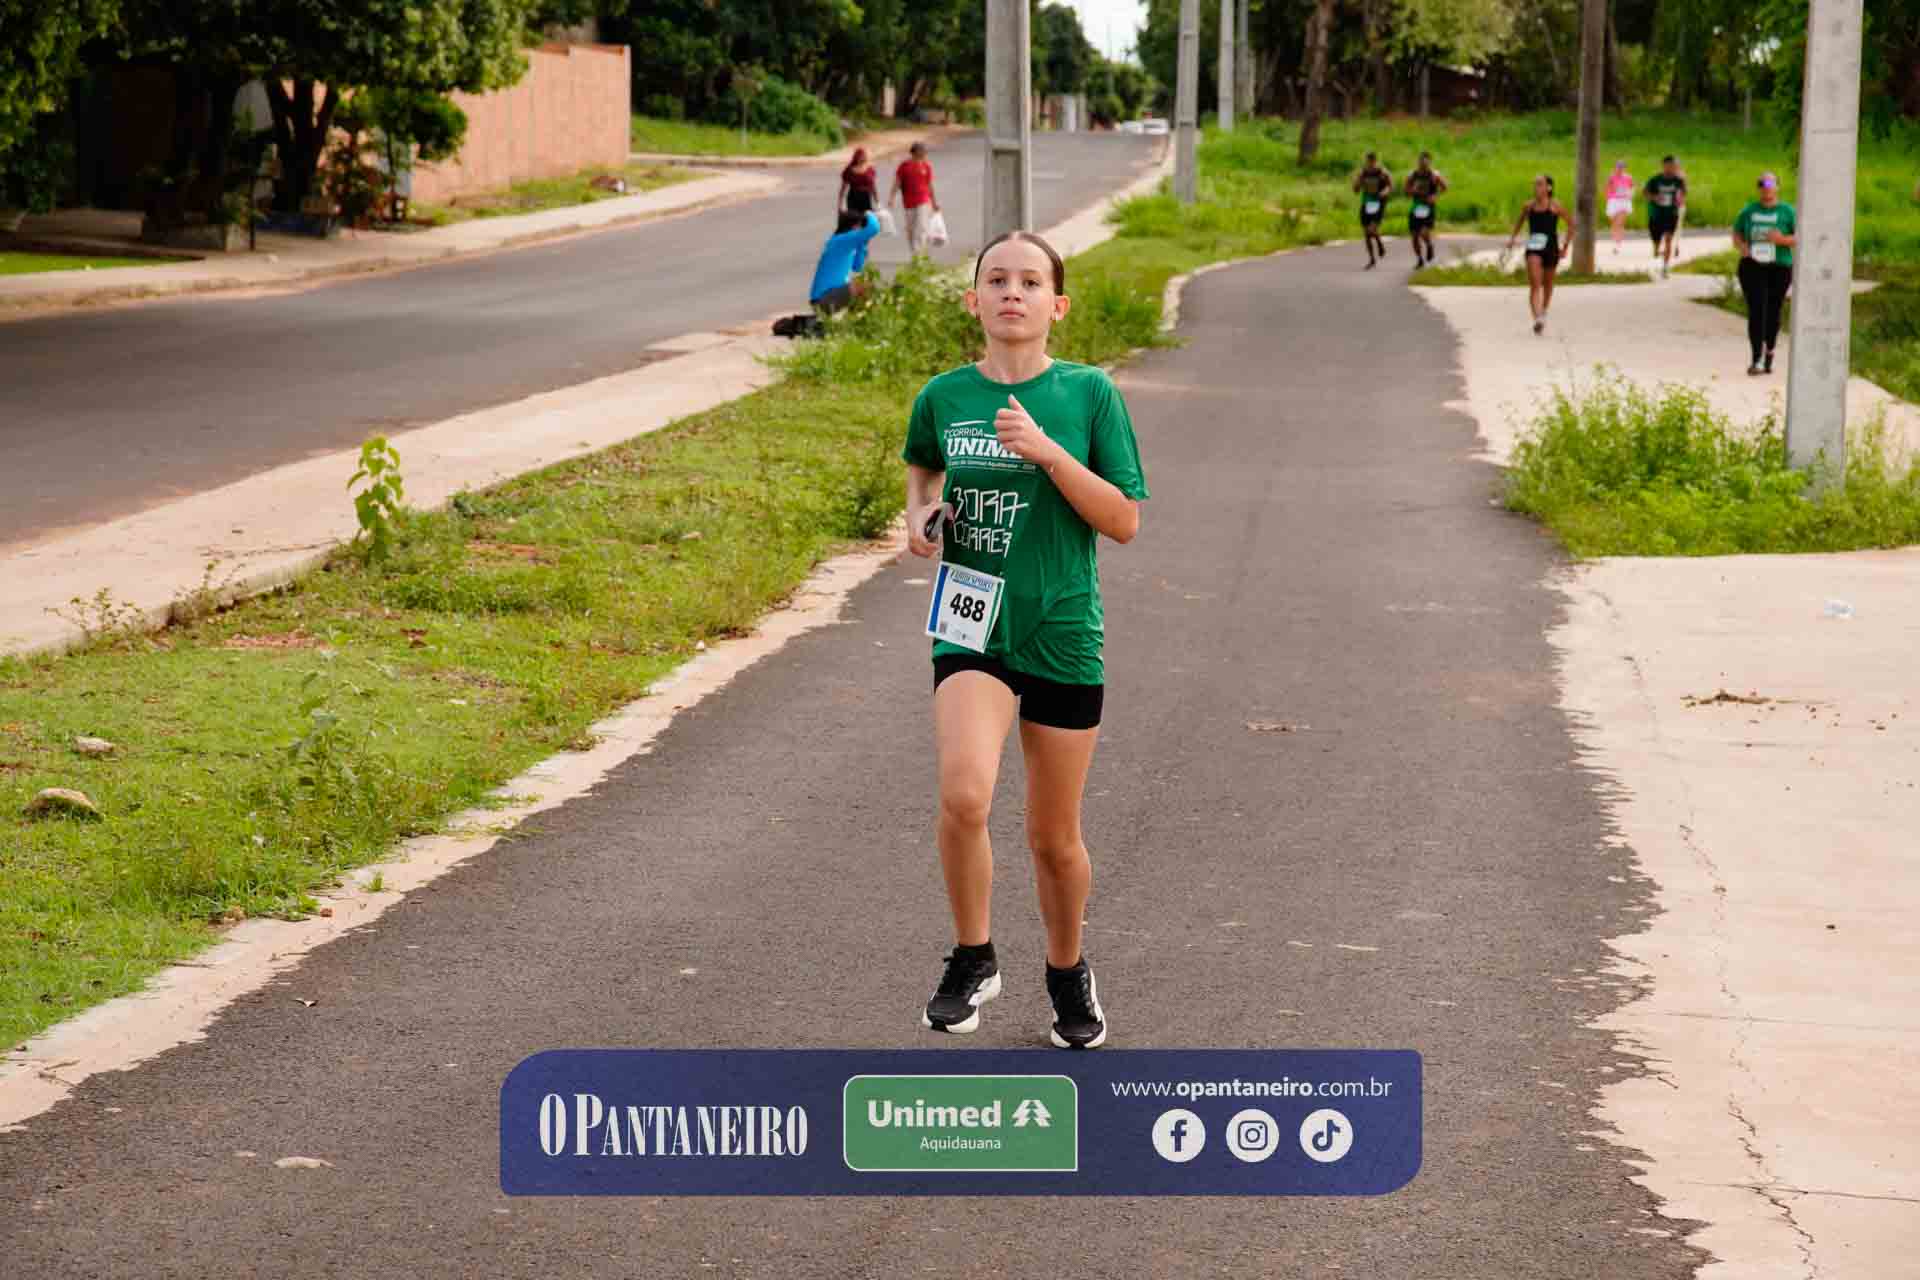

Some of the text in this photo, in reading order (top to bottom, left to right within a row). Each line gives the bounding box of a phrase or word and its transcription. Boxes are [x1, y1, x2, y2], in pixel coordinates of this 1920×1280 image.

[950, 427, 984, 438] CORRIDA
[947, 438, 1023, 459] UNIM
[950, 593, 986, 622] 488
